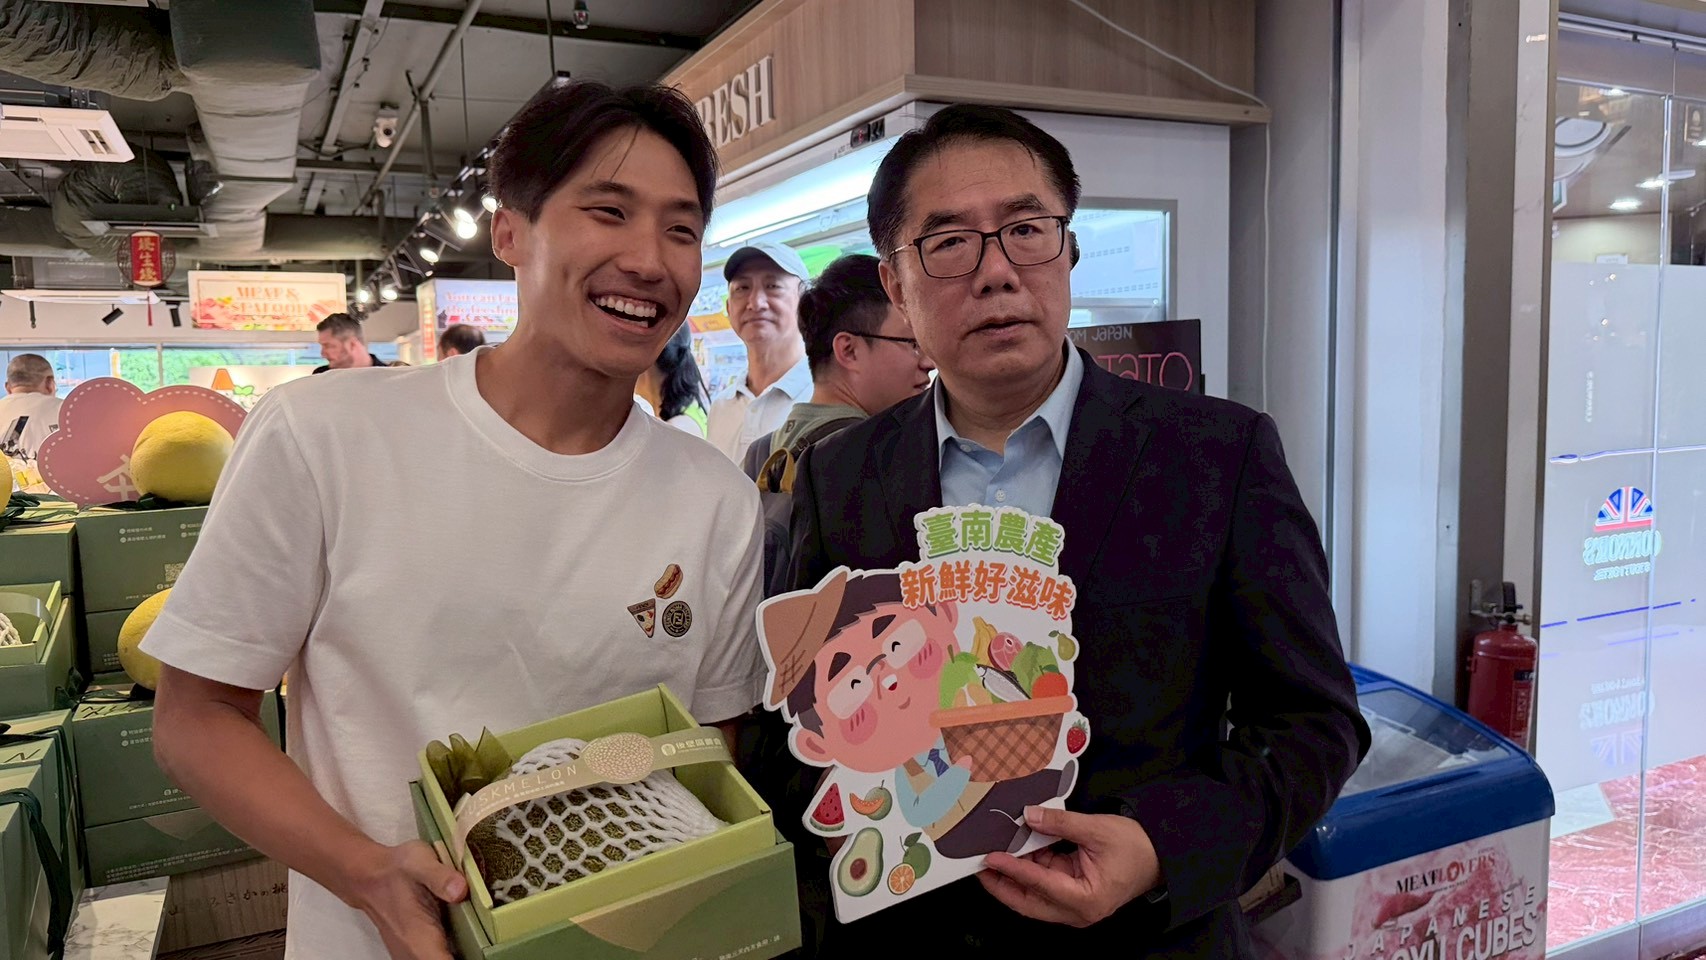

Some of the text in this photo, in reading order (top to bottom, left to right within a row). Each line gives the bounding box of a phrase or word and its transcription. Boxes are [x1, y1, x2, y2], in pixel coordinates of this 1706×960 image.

[694, 54, 774, 150] RESH
[231, 302, 309, 314] SEAFOOD
[237, 286, 283, 298] MEAT
[922, 510, 1063, 565] 臺南農產
[900, 559, 1074, 620] 新鮮好滋味
[1396, 854, 1496, 894] MEATLOVERS
[1345, 886, 1537, 960] JAPANESE
[1455, 908, 1538, 960] CUBES
